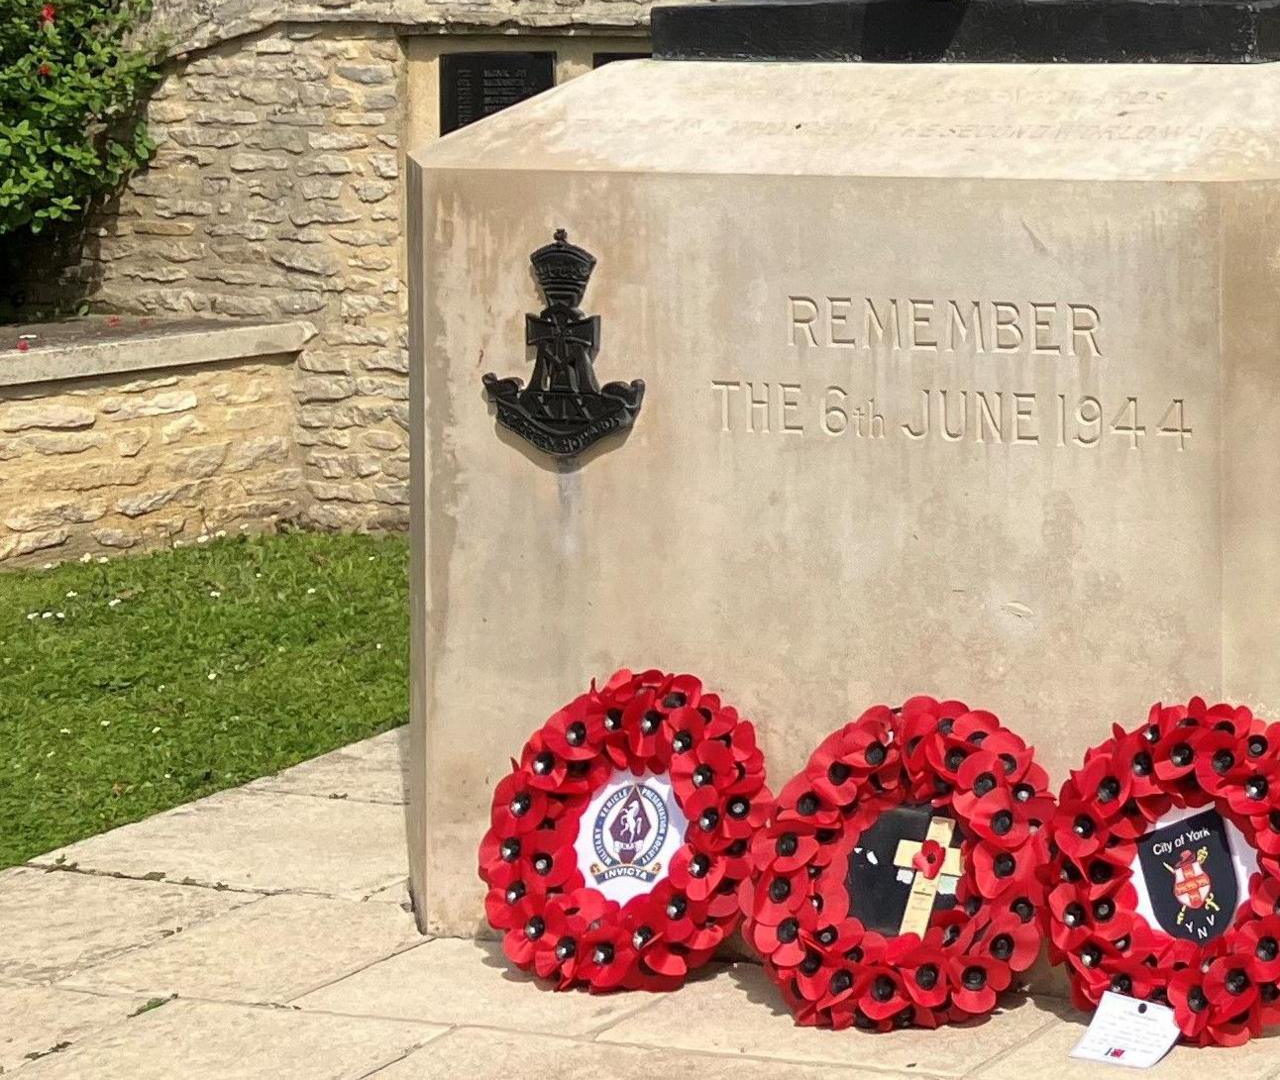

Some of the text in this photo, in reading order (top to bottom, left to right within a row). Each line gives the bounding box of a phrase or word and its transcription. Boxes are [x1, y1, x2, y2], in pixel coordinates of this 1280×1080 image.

[786, 294, 1103, 357] REMEMBER
[711, 379, 1194, 452] THE 6th JUNE 1944
[600, 788, 629, 818] VEHICLE
[594, 827, 613, 866] MILITARY
[642, 835, 666, 865] SOCIETY
[1152, 827, 1211, 856] City of York
[603, 866, 648, 881] INVICTA
